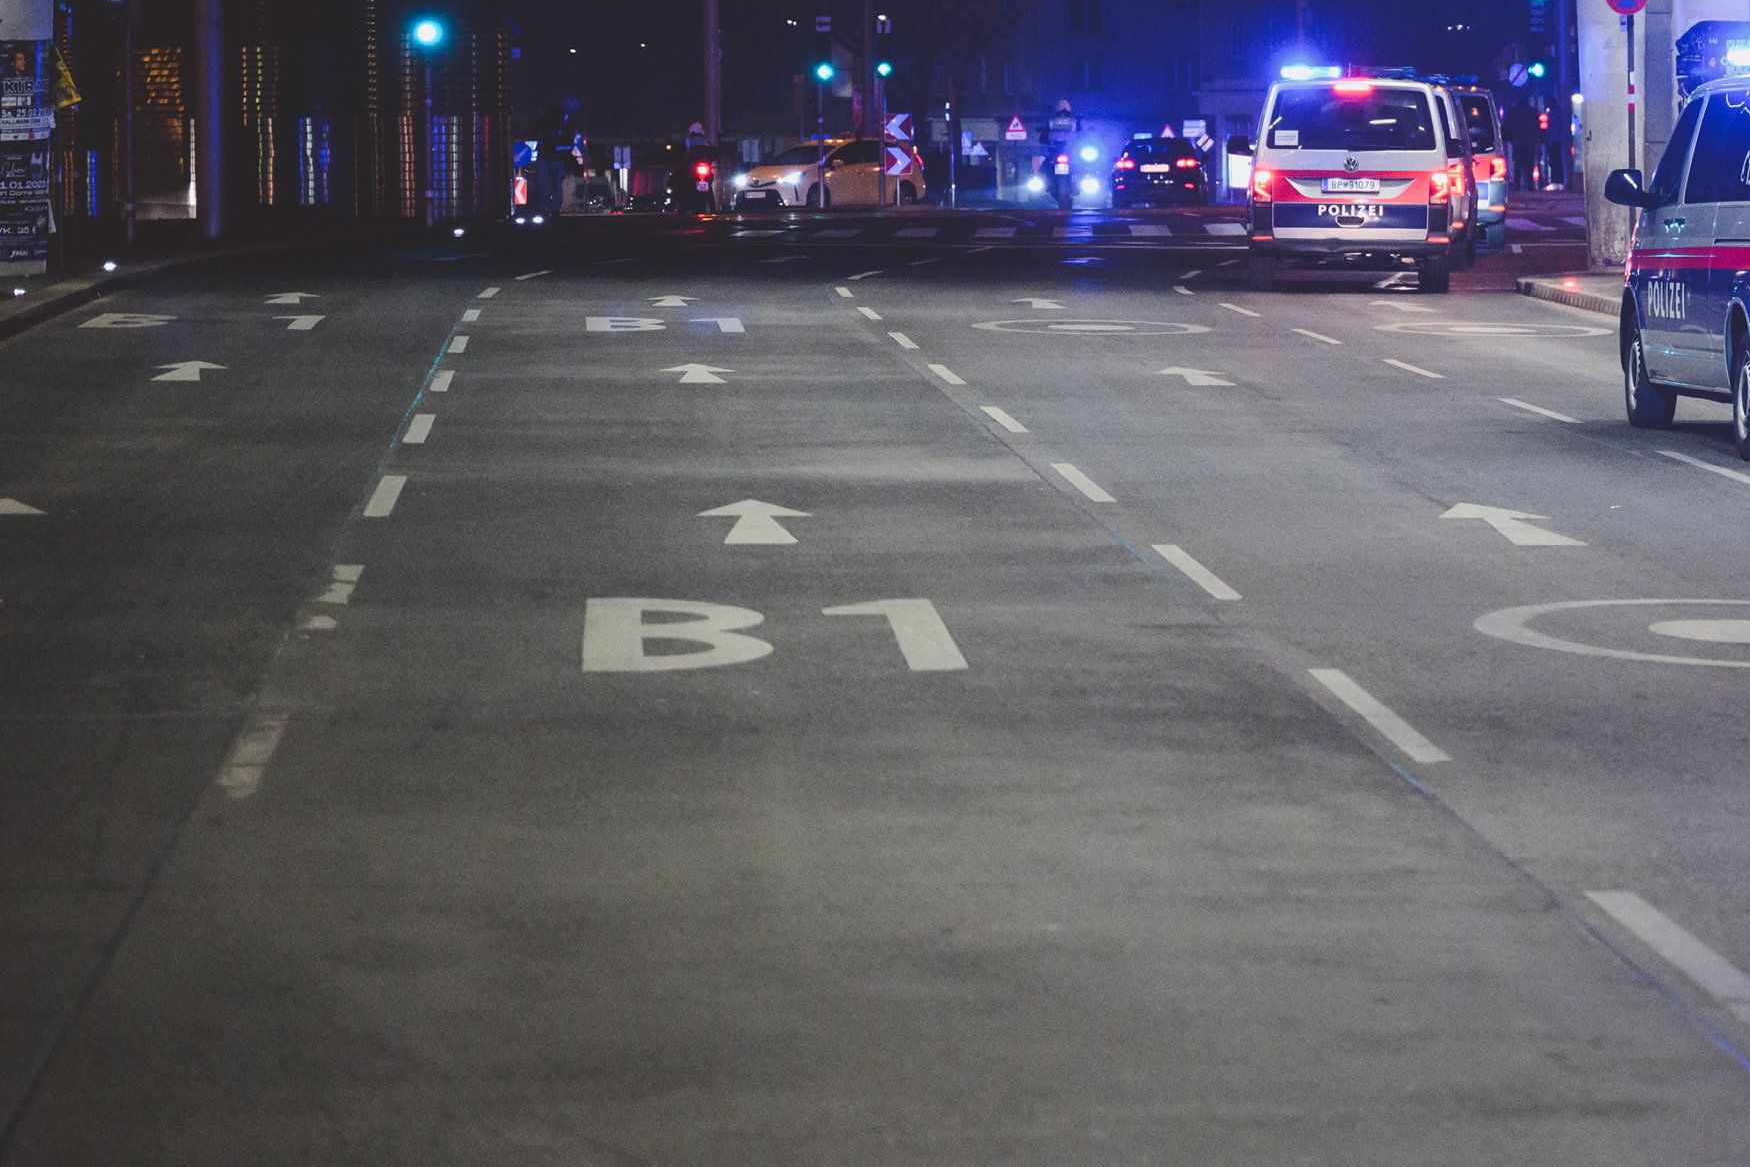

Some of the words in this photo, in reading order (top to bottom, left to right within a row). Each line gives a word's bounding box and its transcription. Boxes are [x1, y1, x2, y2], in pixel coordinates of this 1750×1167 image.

[1331, 180, 1343, 190] BP
[1349, 180, 1376, 190] 91079
[1317, 204, 1384, 217] POLIZEI
[1648, 280, 1686, 320] POLIZEI
